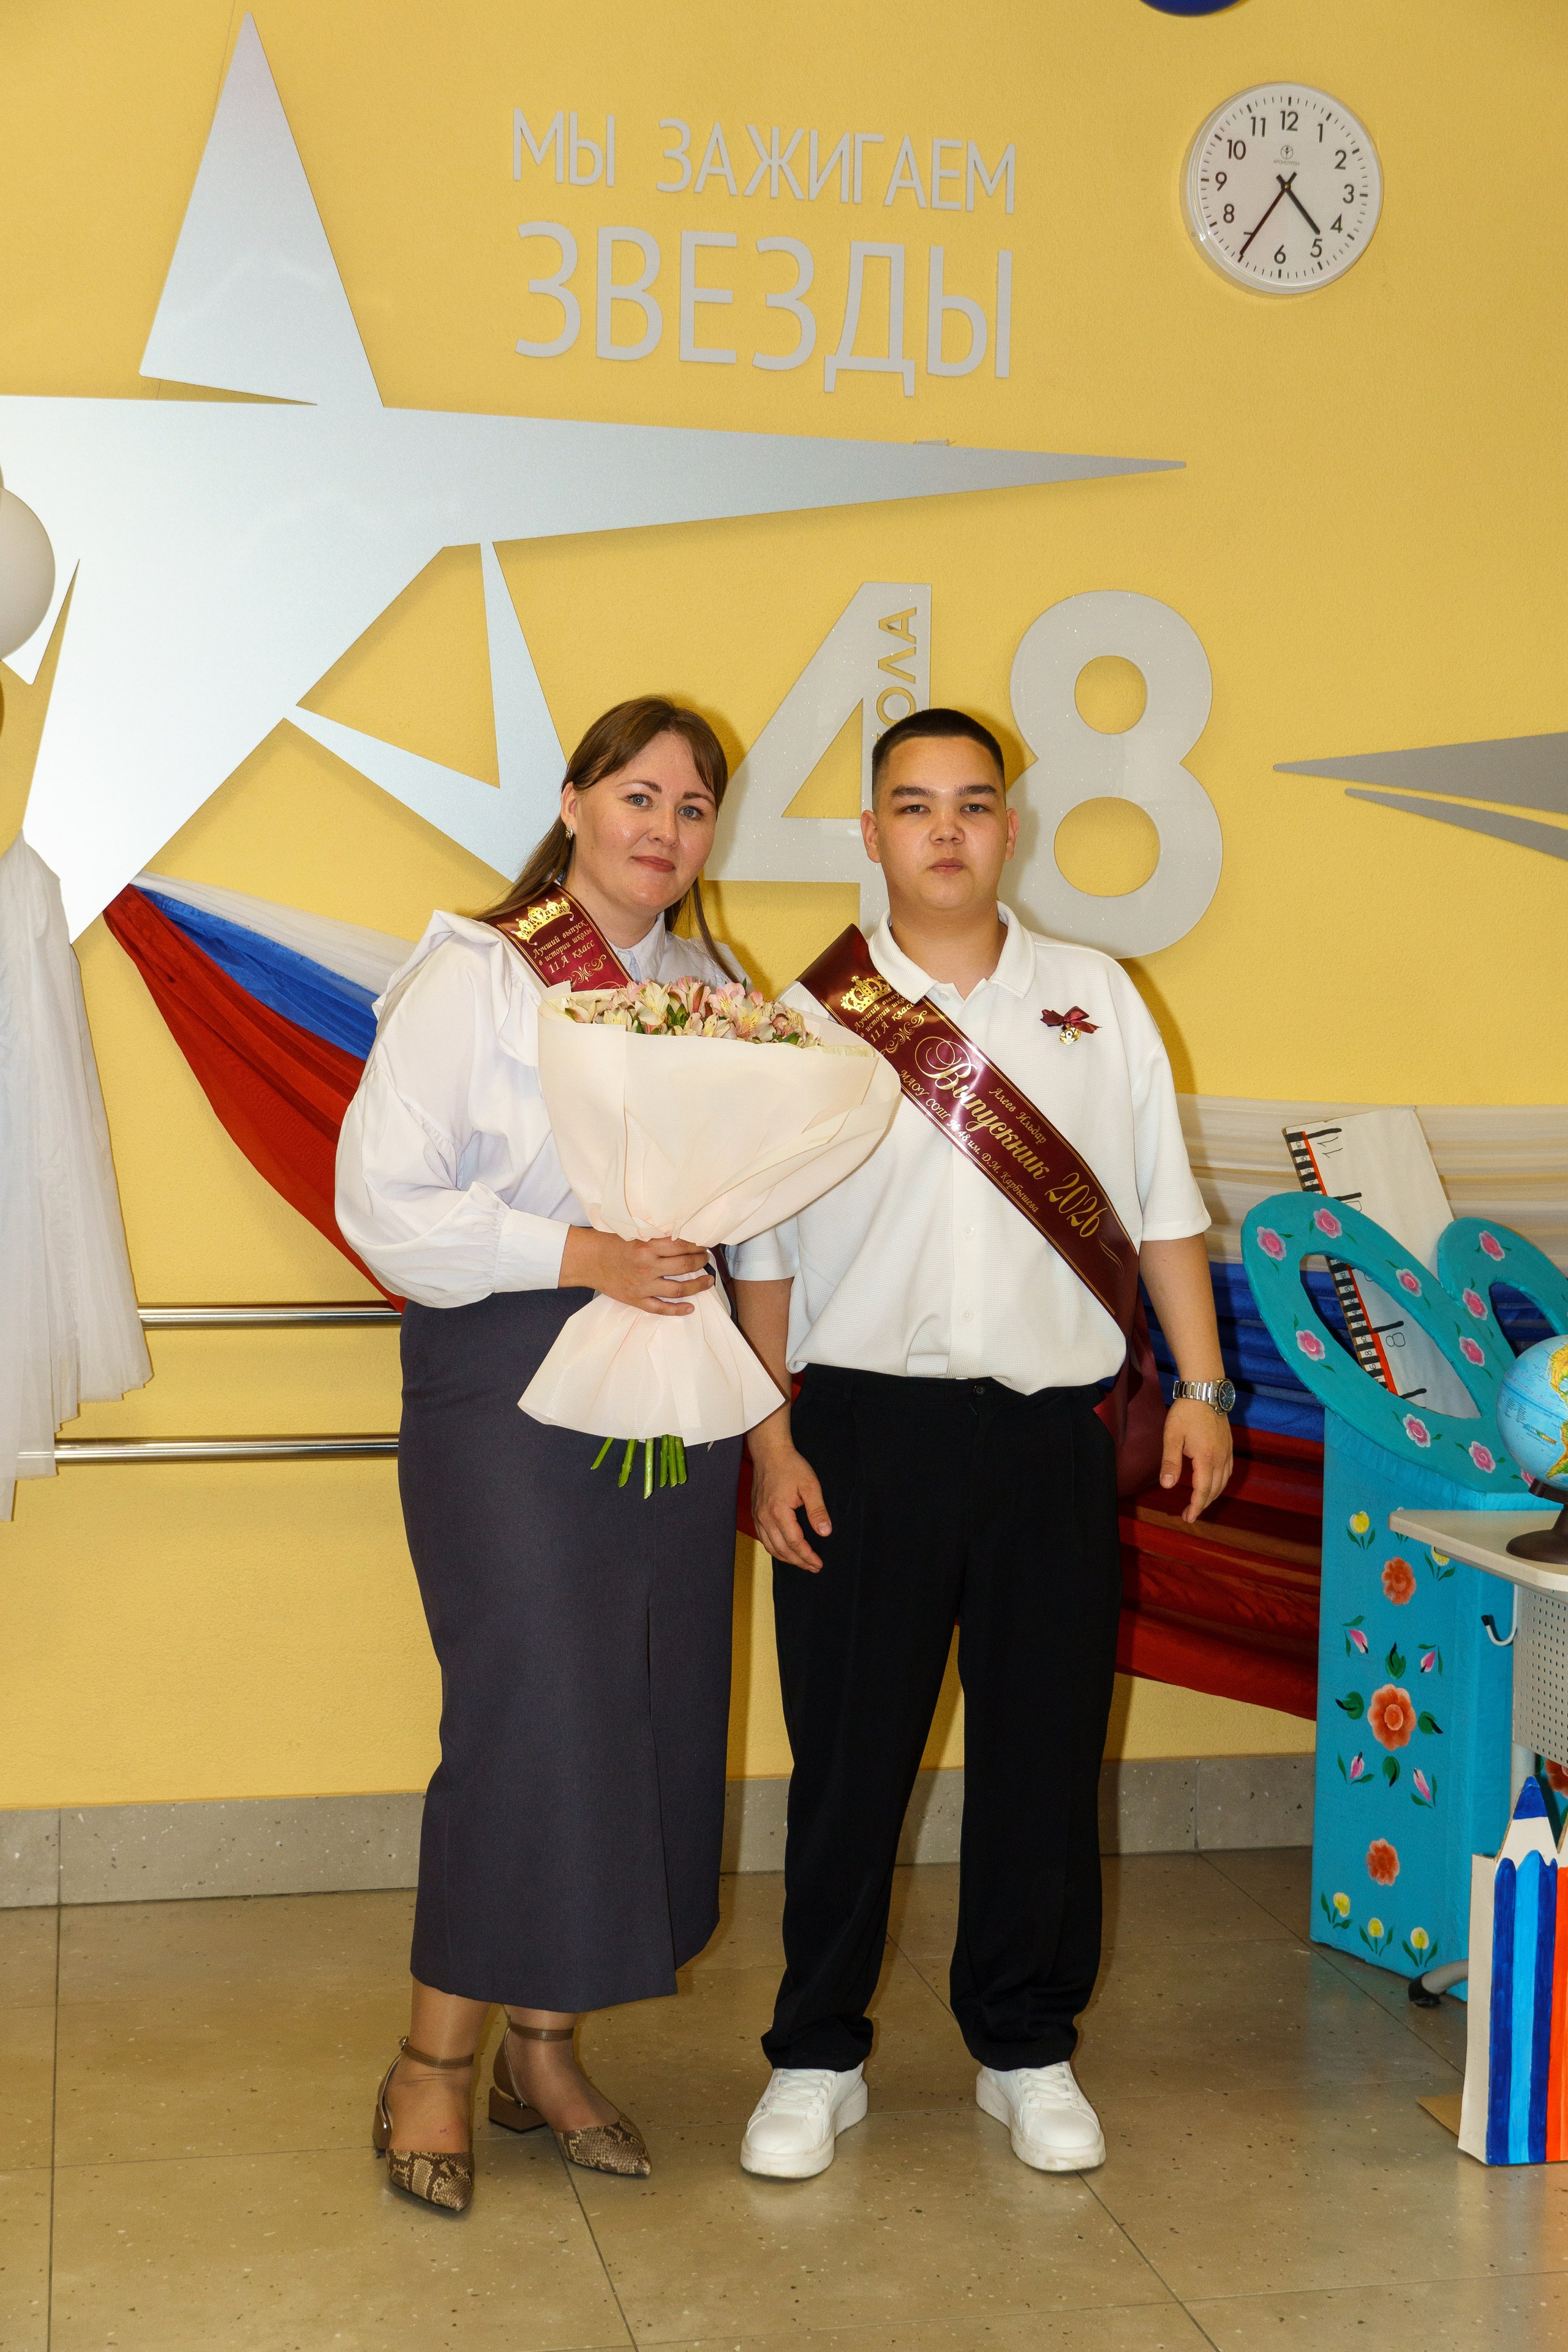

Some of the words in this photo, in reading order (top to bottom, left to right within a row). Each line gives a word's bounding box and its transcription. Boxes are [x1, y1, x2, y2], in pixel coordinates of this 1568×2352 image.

[1251, 116, 1266, 137] 11
[1280, 110, 1298, 131] 12
[1317, 123, 1323, 143] 1
[513, 108, 615, 187] МЫ
[656, 118, 1016, 214] ЗАЖИГАЕМ
[1227, 139, 1246, 160] 10
[1334, 149, 1347, 170] 2
[1215, 172, 1227, 192] 9
[1343, 184, 1354, 204] 3
[1223, 203, 1235, 224] 8
[1330, 213, 1344, 234] 4
[1274, 245, 1286, 265] 6
[1310, 239, 1323, 258] 5
[514, 221, 1012, 398] ЗВЕЗДЫ
[704, 581, 1224, 959] 48
[533, 935, 560, 959] Лучший
[562, 919, 589, 939] выпуск
[544, 941, 571, 962] истории
[571, 927, 592, 944] школы
[548, 960, 560, 974] 11
[560, 955, 570, 968] А
[571, 939, 595, 959] класс
[853, 1003, 881, 1033] Лучший
[881, 991, 900, 1006] выпу
[865, 1006, 891, 1033] истории
[891, 997, 907, 1009] шко
[870, 1029, 881, 1043] 11
[881, 1020, 890, 1034] А
[989, 1087, 1017, 1113] Алеев
[1016, 1111, 1047, 1145] Ильдар
[900, 1069, 930, 1096] МАОУ
[925, 1098, 952, 1120] СОШ
[946, 1120, 962, 1132] №
[957, 1131, 970, 1142] 48
[967, 1140, 980, 1155] им.
[981, 1152, 1002, 1174] Д.М.
[1000, 1171, 1039, 1213] Карбышева
[914, 1036, 1050, 1180] Выпускник
[1044, 1172, 1108, 1238] 2026
[1317, 1136, 1343, 1159] 11
[1385, 1332, 1406, 1348] 8
